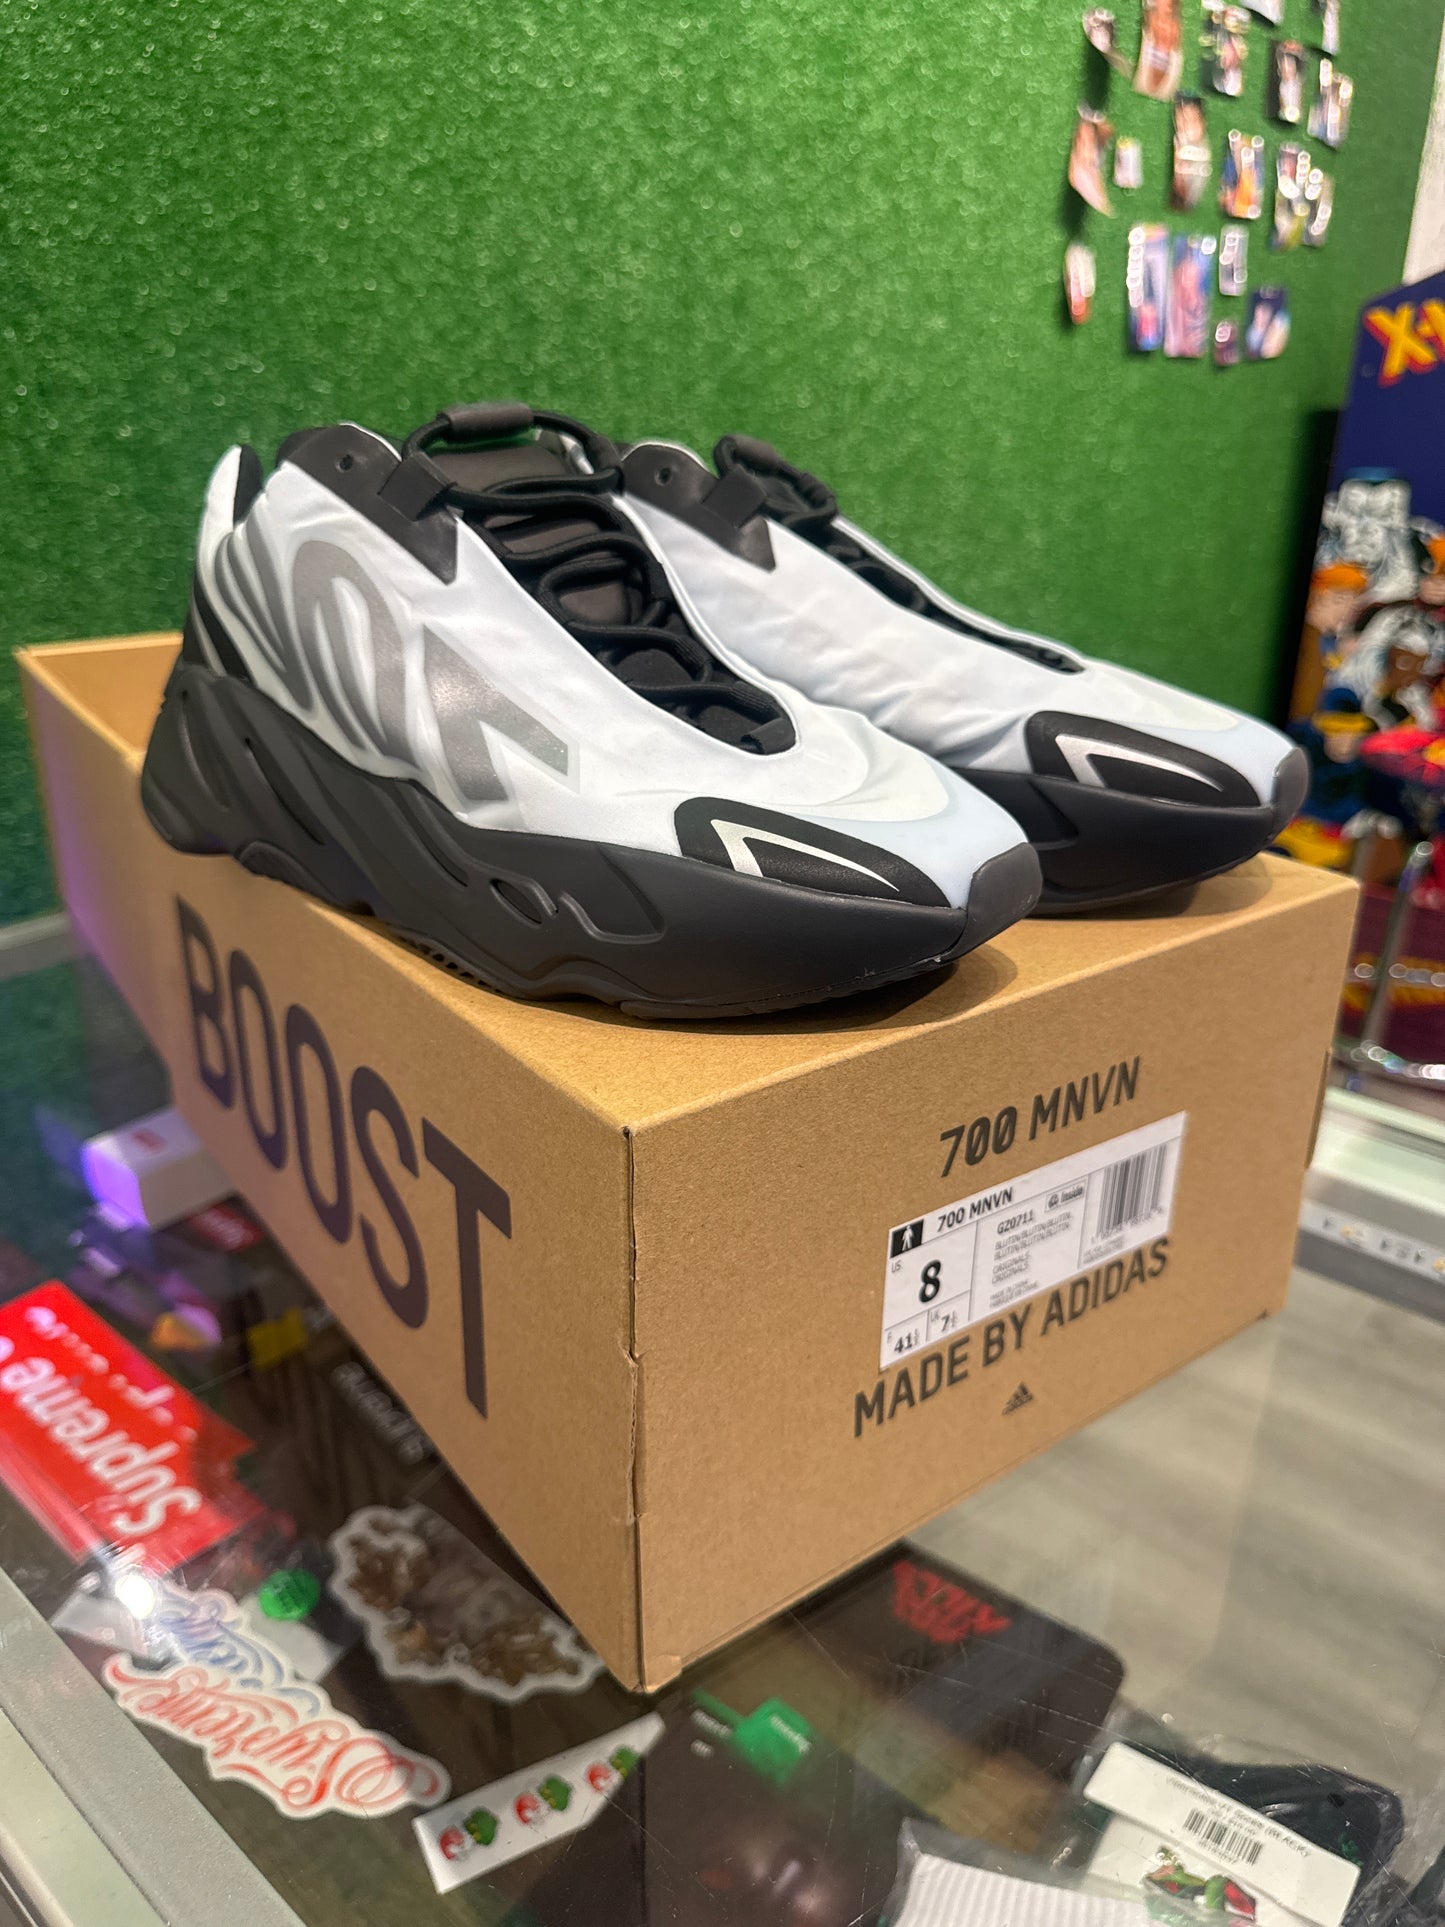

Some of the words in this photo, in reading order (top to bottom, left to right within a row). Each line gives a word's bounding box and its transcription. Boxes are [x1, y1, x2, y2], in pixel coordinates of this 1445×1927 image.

[177, 893, 512, 1419] BOOST
[939, 1105, 1018, 1178] 700
[1028, 1055, 1140, 1141] MNVN
[937, 1207, 965, 1232] 700
[969, 1187, 1013, 1217] MNVN
[997, 1209, 1034, 1235] GZ0711
[892, 1260, 902, 1273] US
[919, 1259, 942, 1303] 8
[854, 1335, 971, 1438] MADE
[982, 1303, 1032, 1368] BY
[1040, 1237, 1169, 1337] ADIDAS
[1, 1357, 202, 1536] Supreme
